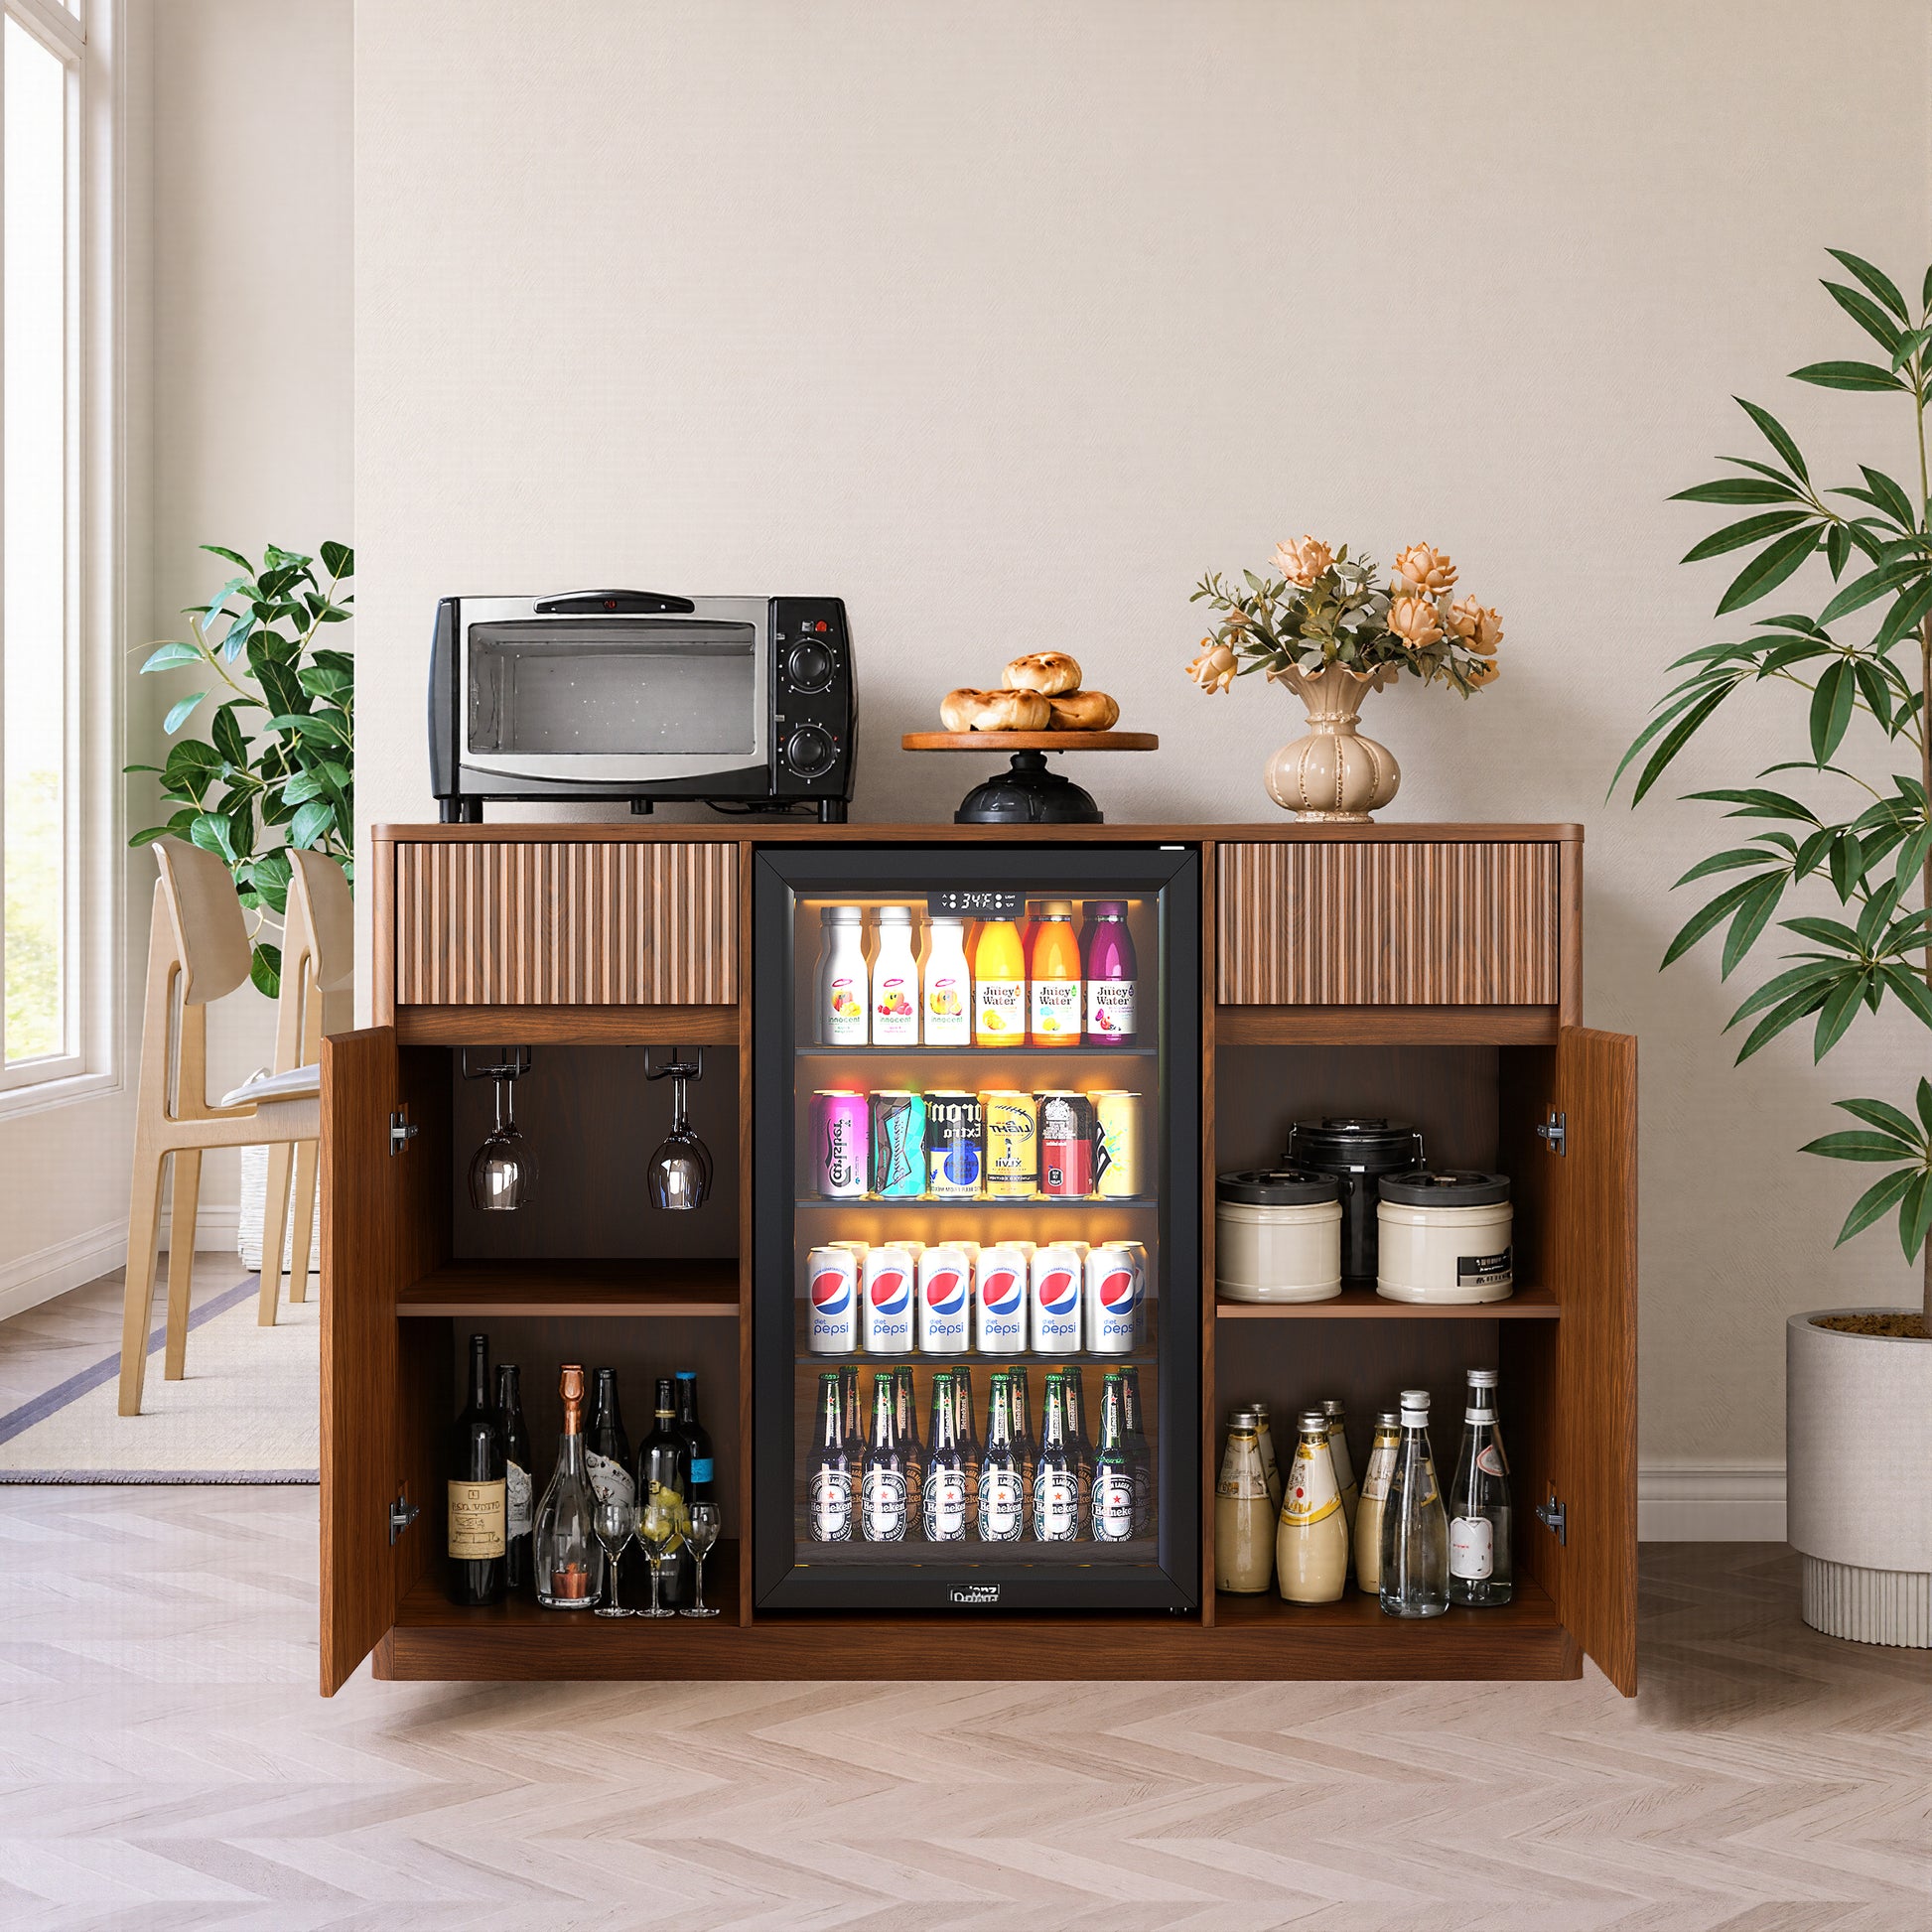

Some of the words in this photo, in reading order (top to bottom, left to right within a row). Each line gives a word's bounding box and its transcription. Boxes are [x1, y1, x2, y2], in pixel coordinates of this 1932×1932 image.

[983, 987, 1014, 998] Juicy
[1039, 987, 1070, 998] Juicy
[1097, 987, 1128, 998] Juicy
[983, 996, 1016, 1006] Water
[1039, 996, 1072, 1006] Water
[1096, 996, 1130, 1006] Water
[813, 1321, 849, 1335] pepsi
[873, 1321, 908, 1335] pepsi
[929, 1321, 964, 1335] pepsi
[985, 1321, 1020, 1336] pepsi
[1041, 1321, 1076, 1336] pepsi
[864, 1500, 905, 1513] Heneken
[980, 1500, 1023, 1513] Heneken
[1036, 1502, 1078, 1514] Hneken
[1095, 1505, 1134, 1517] Heineke
